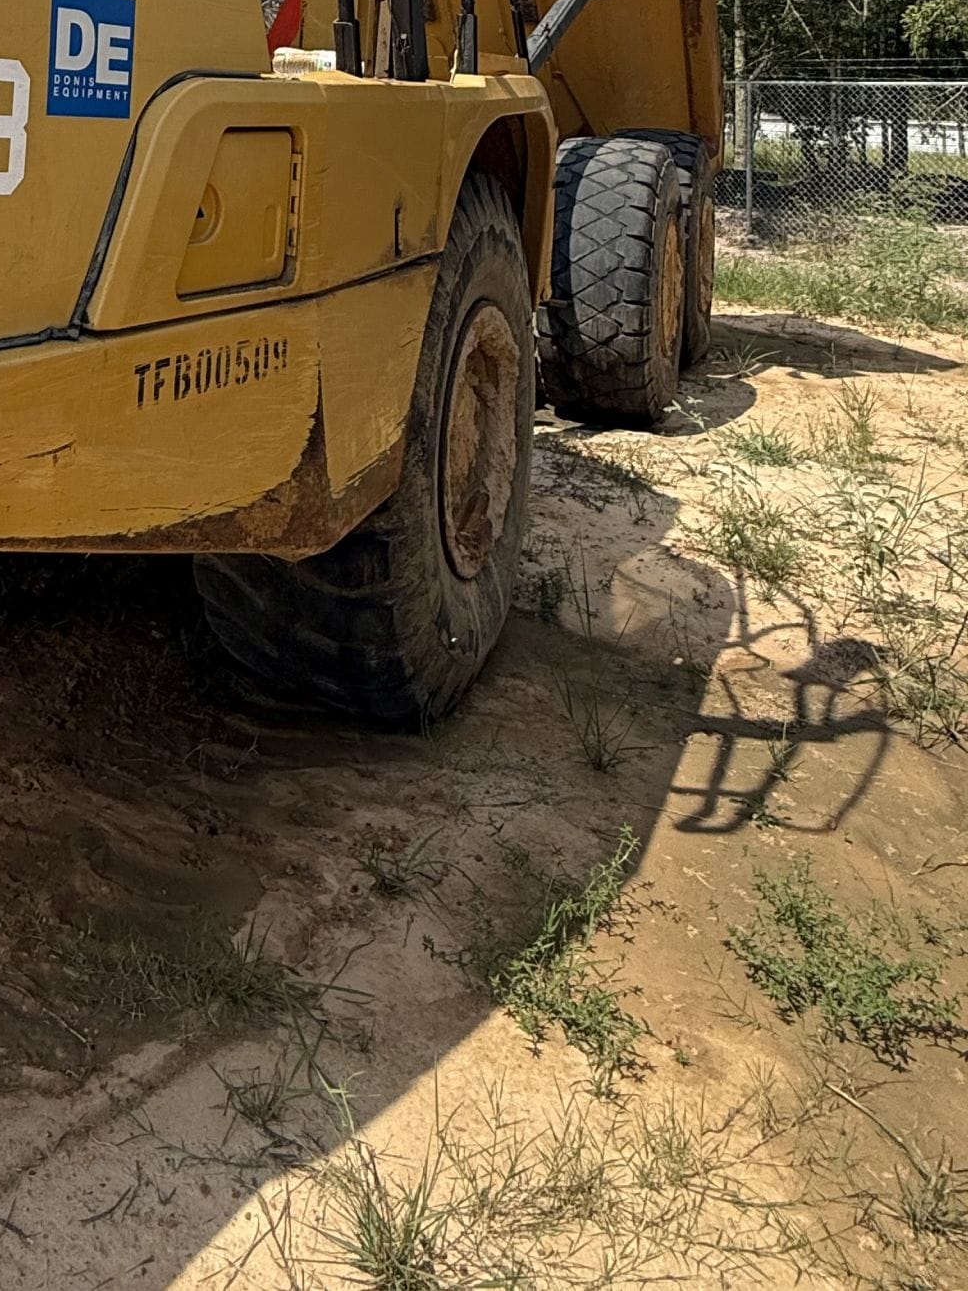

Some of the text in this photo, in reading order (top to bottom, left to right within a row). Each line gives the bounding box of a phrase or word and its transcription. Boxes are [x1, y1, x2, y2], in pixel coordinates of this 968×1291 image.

[55, 7, 131, 85] DE
[54, 74, 95, 87] DONIS
[53, 87, 129, 101] EQUIPMENT
